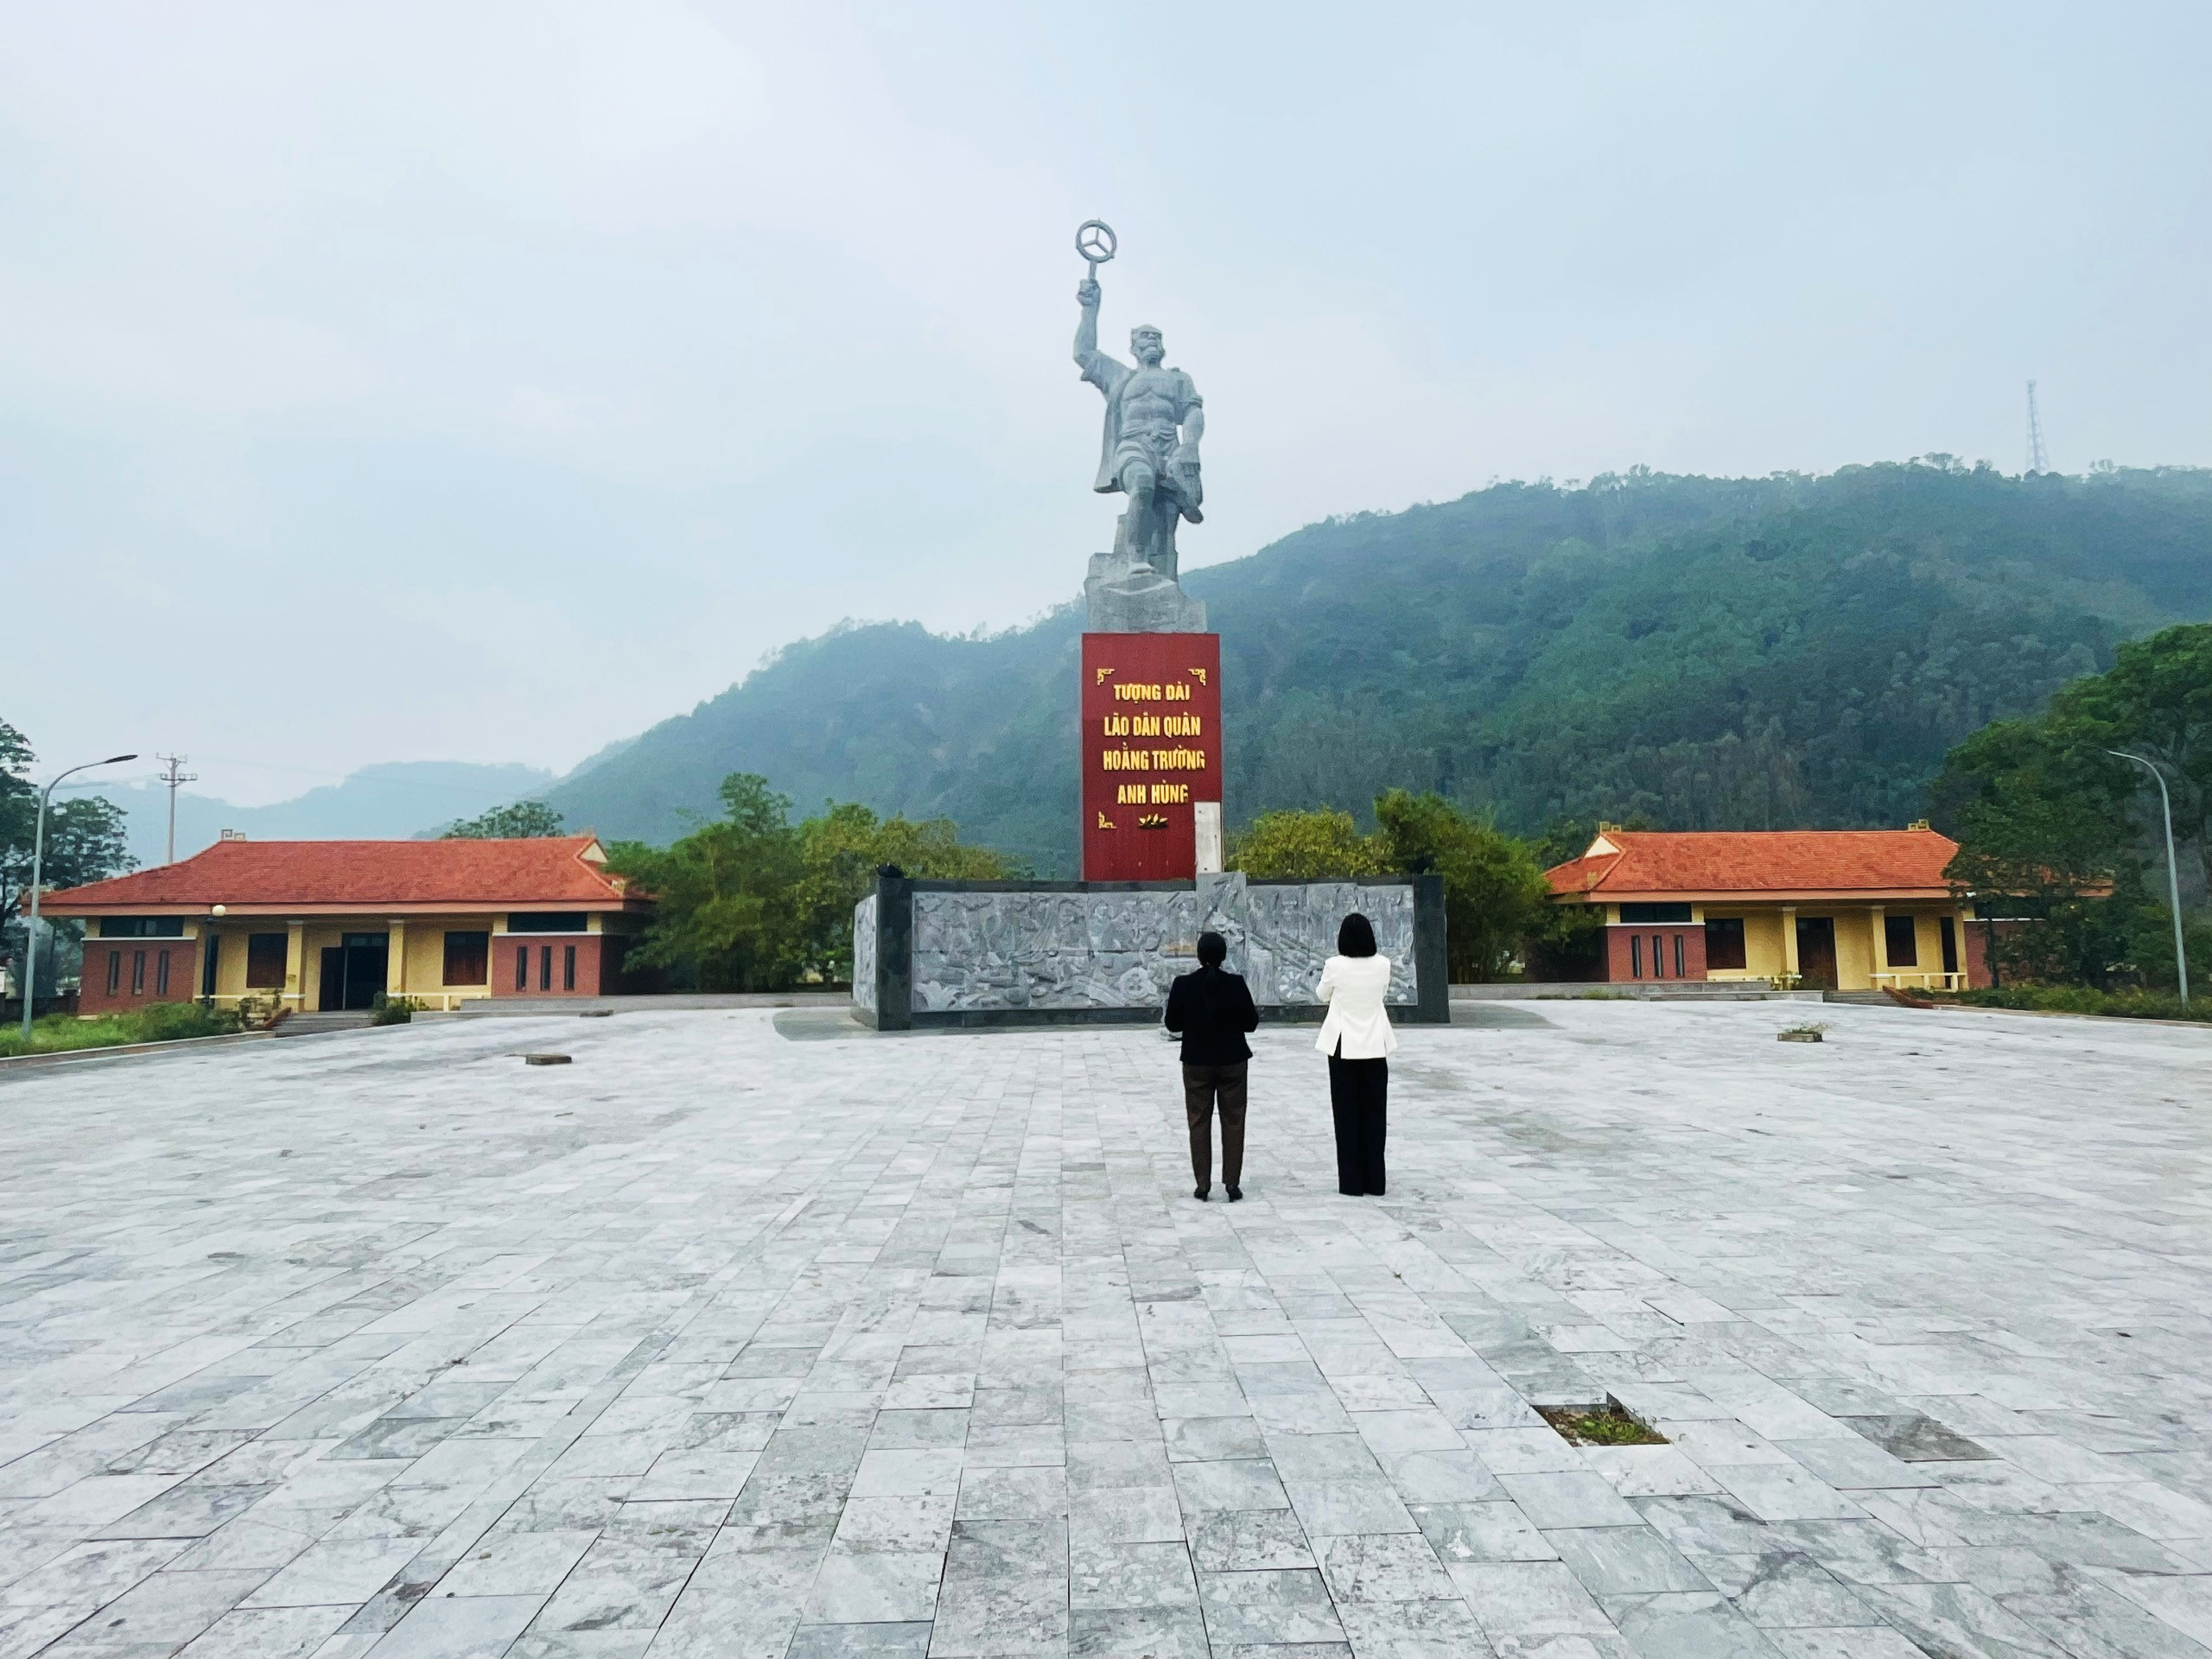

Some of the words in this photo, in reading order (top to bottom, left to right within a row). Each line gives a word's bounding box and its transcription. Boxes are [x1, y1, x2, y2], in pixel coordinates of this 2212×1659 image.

[1113, 683, 1162, 704] TƯỢNG
[1165, 680, 1191, 701] ĐÀI
[1103, 711, 1130, 736] LÃO
[1132, 711, 1160, 736] DÂN
[1163, 711, 1201, 739] QUÂN
[1152, 744, 1205, 771] TRƯỜNG
[1117, 784, 1147, 804] ANH
